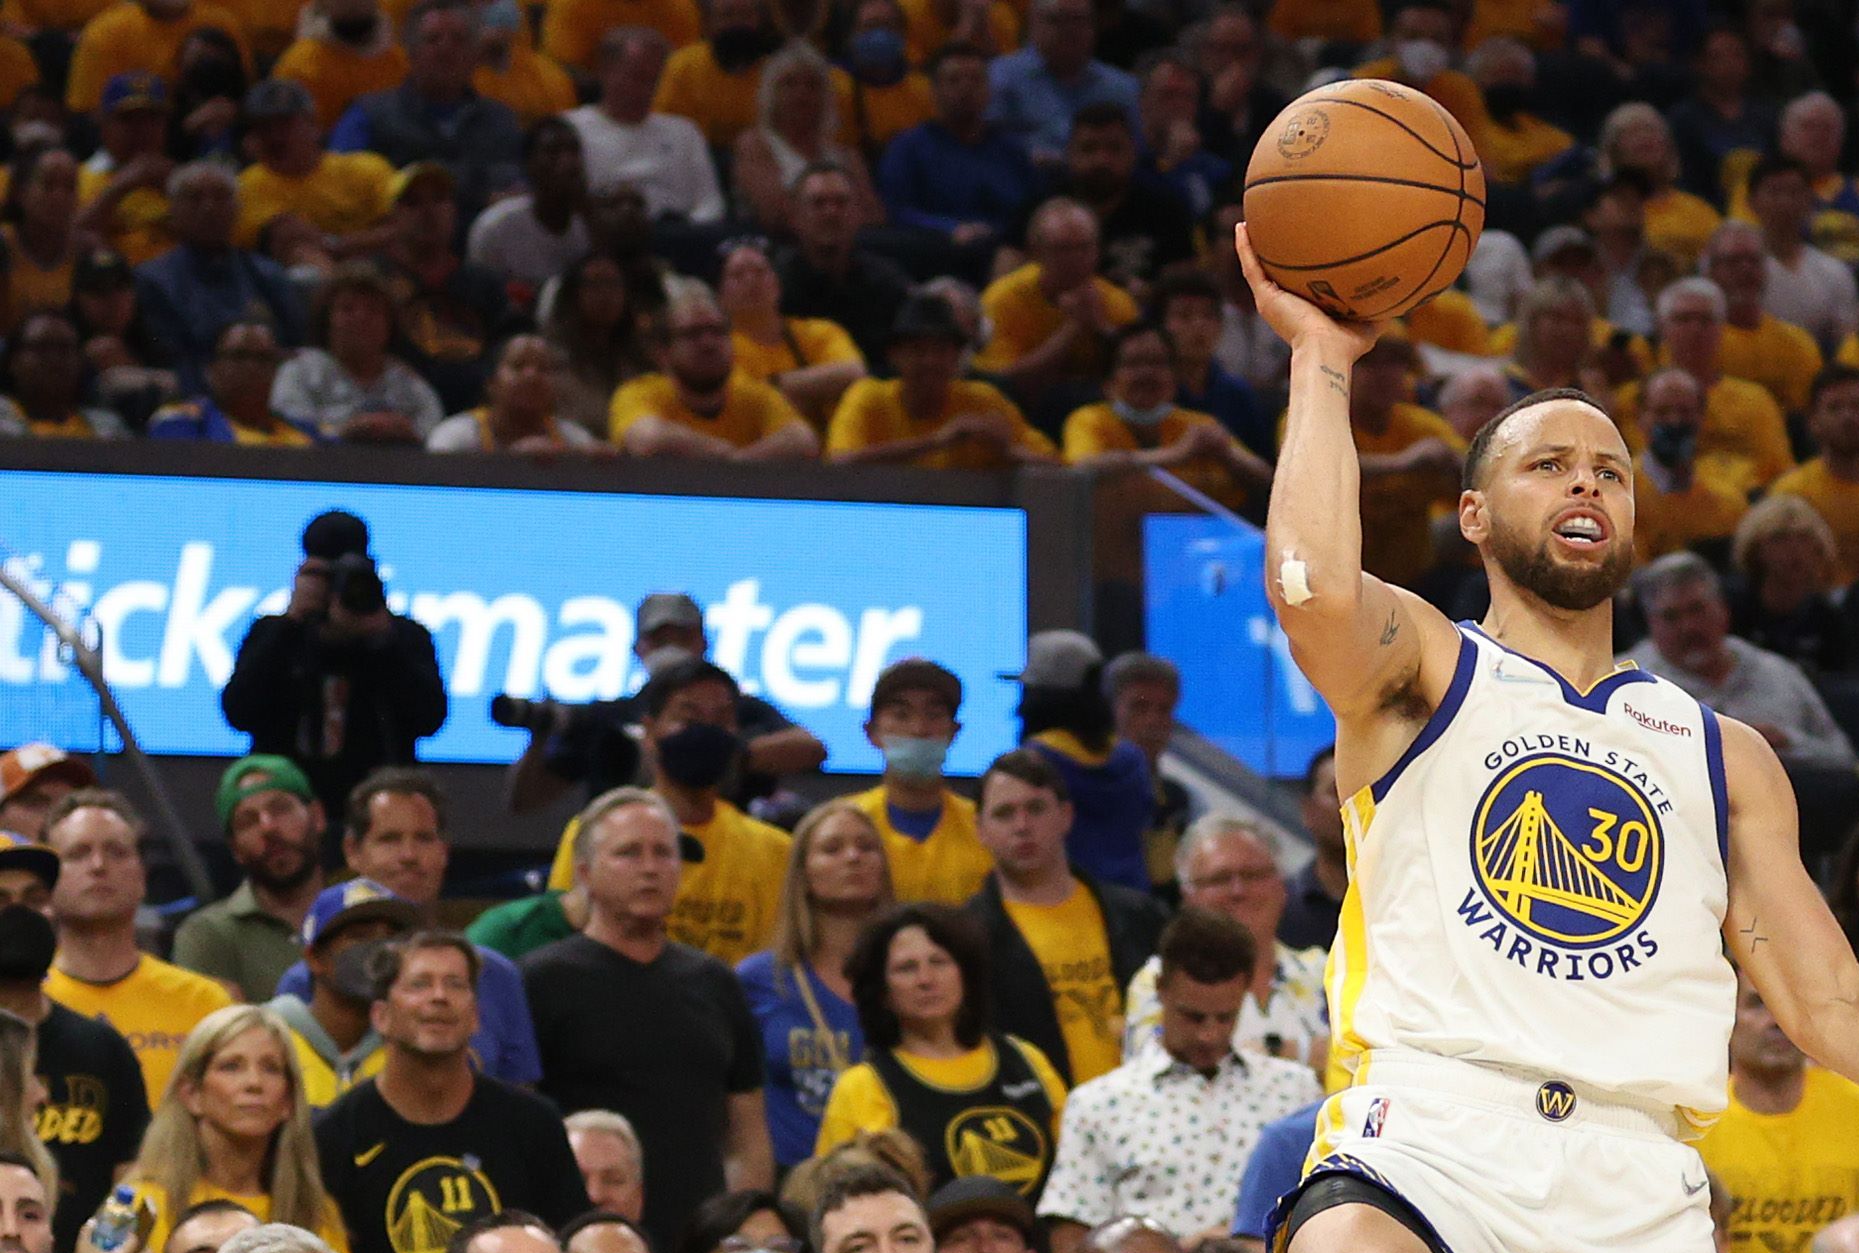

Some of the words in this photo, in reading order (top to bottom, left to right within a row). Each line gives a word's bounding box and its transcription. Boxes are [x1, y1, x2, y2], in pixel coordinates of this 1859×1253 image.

[0, 540, 921, 708] tickmater
[1623, 702, 1692, 737] Rakuten
[1484, 734, 1591, 770] GOLDEN
[1604, 750, 1673, 816] STATE
[1581, 807, 1649, 873] 30
[1456, 887, 1659, 980] WARRIORS
[1540, 1088, 1575, 1117] W
[440, 1176, 474, 1213] 11
